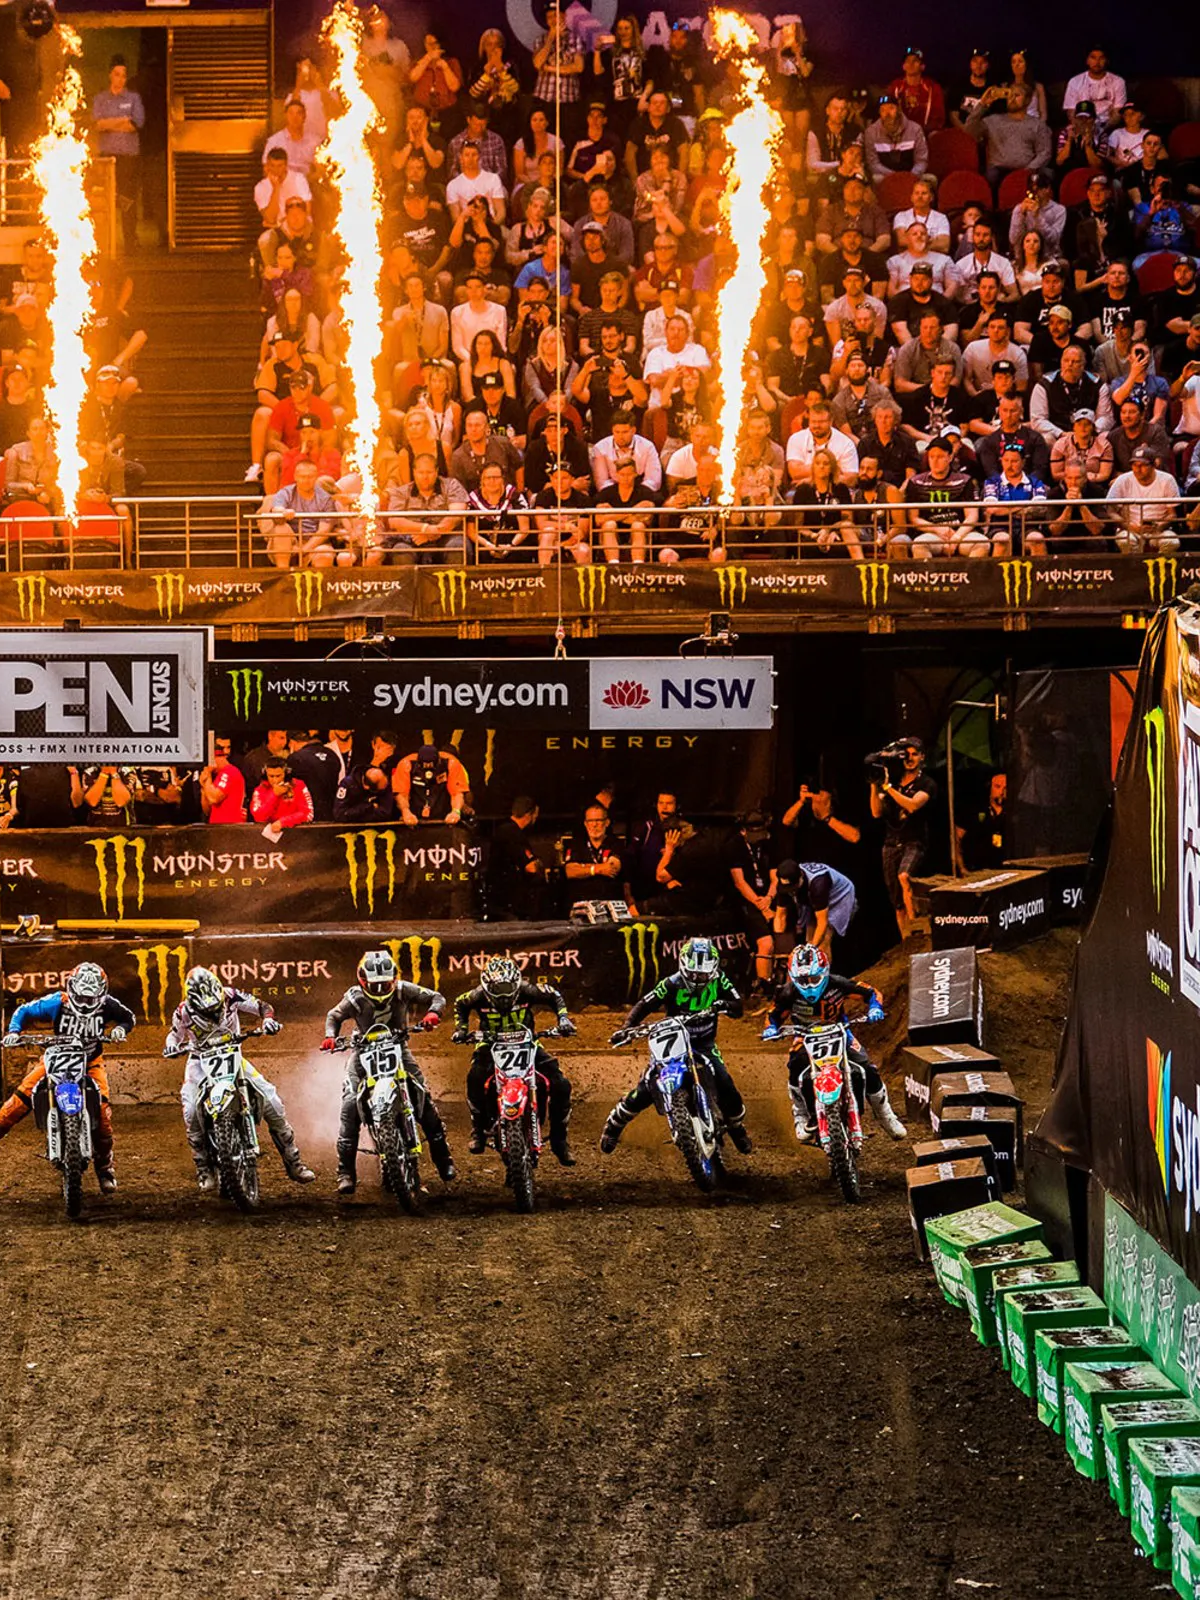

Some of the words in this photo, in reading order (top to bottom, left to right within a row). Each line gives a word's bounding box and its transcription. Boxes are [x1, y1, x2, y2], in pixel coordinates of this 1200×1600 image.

[610, 573, 686, 588] MONSTER
[751, 573, 827, 587] MONSTER
[893, 570, 970, 584] MONSTER
[1036, 568, 1114, 582] MONSTER
[50, 583, 124, 598] MONSTER
[188, 581, 263, 595] MONSTER
[326, 578, 401, 593] MONSTER
[470, 576, 546, 592] MONSTER
[338, 590, 392, 600] ENERGY
[482, 590, 535, 598] ENERGY
[267, 677, 350, 693] MONSTER
[152, 661, 171, 732] SYDNEY
[373, 676, 568, 714] sydney.com
[661, 678, 756, 709] NSW
[39, 743, 68, 754] FMX
[73, 743, 181, 754] INTERNATIONAL
[546, 736, 699, 750] ENERGY
[153, 849, 288, 877] MONSTER
[175, 876, 268, 889] ENERGY
[935, 913, 988, 926] sydney.com
[999, 897, 1044, 929] sydney.com
[662, 932, 750, 958] MTER
[448, 949, 582, 974] MOSTER
[932, 957, 955, 1018] sydney.com
[656, 1033, 679, 1058] 7
[812, 1040, 841, 1059] 51
[48, 1053, 85, 1074] 122
[208, 1054, 236, 1078] 21
[365, 1049, 397, 1075] 15
[500, 1051, 529, 1071] 24
